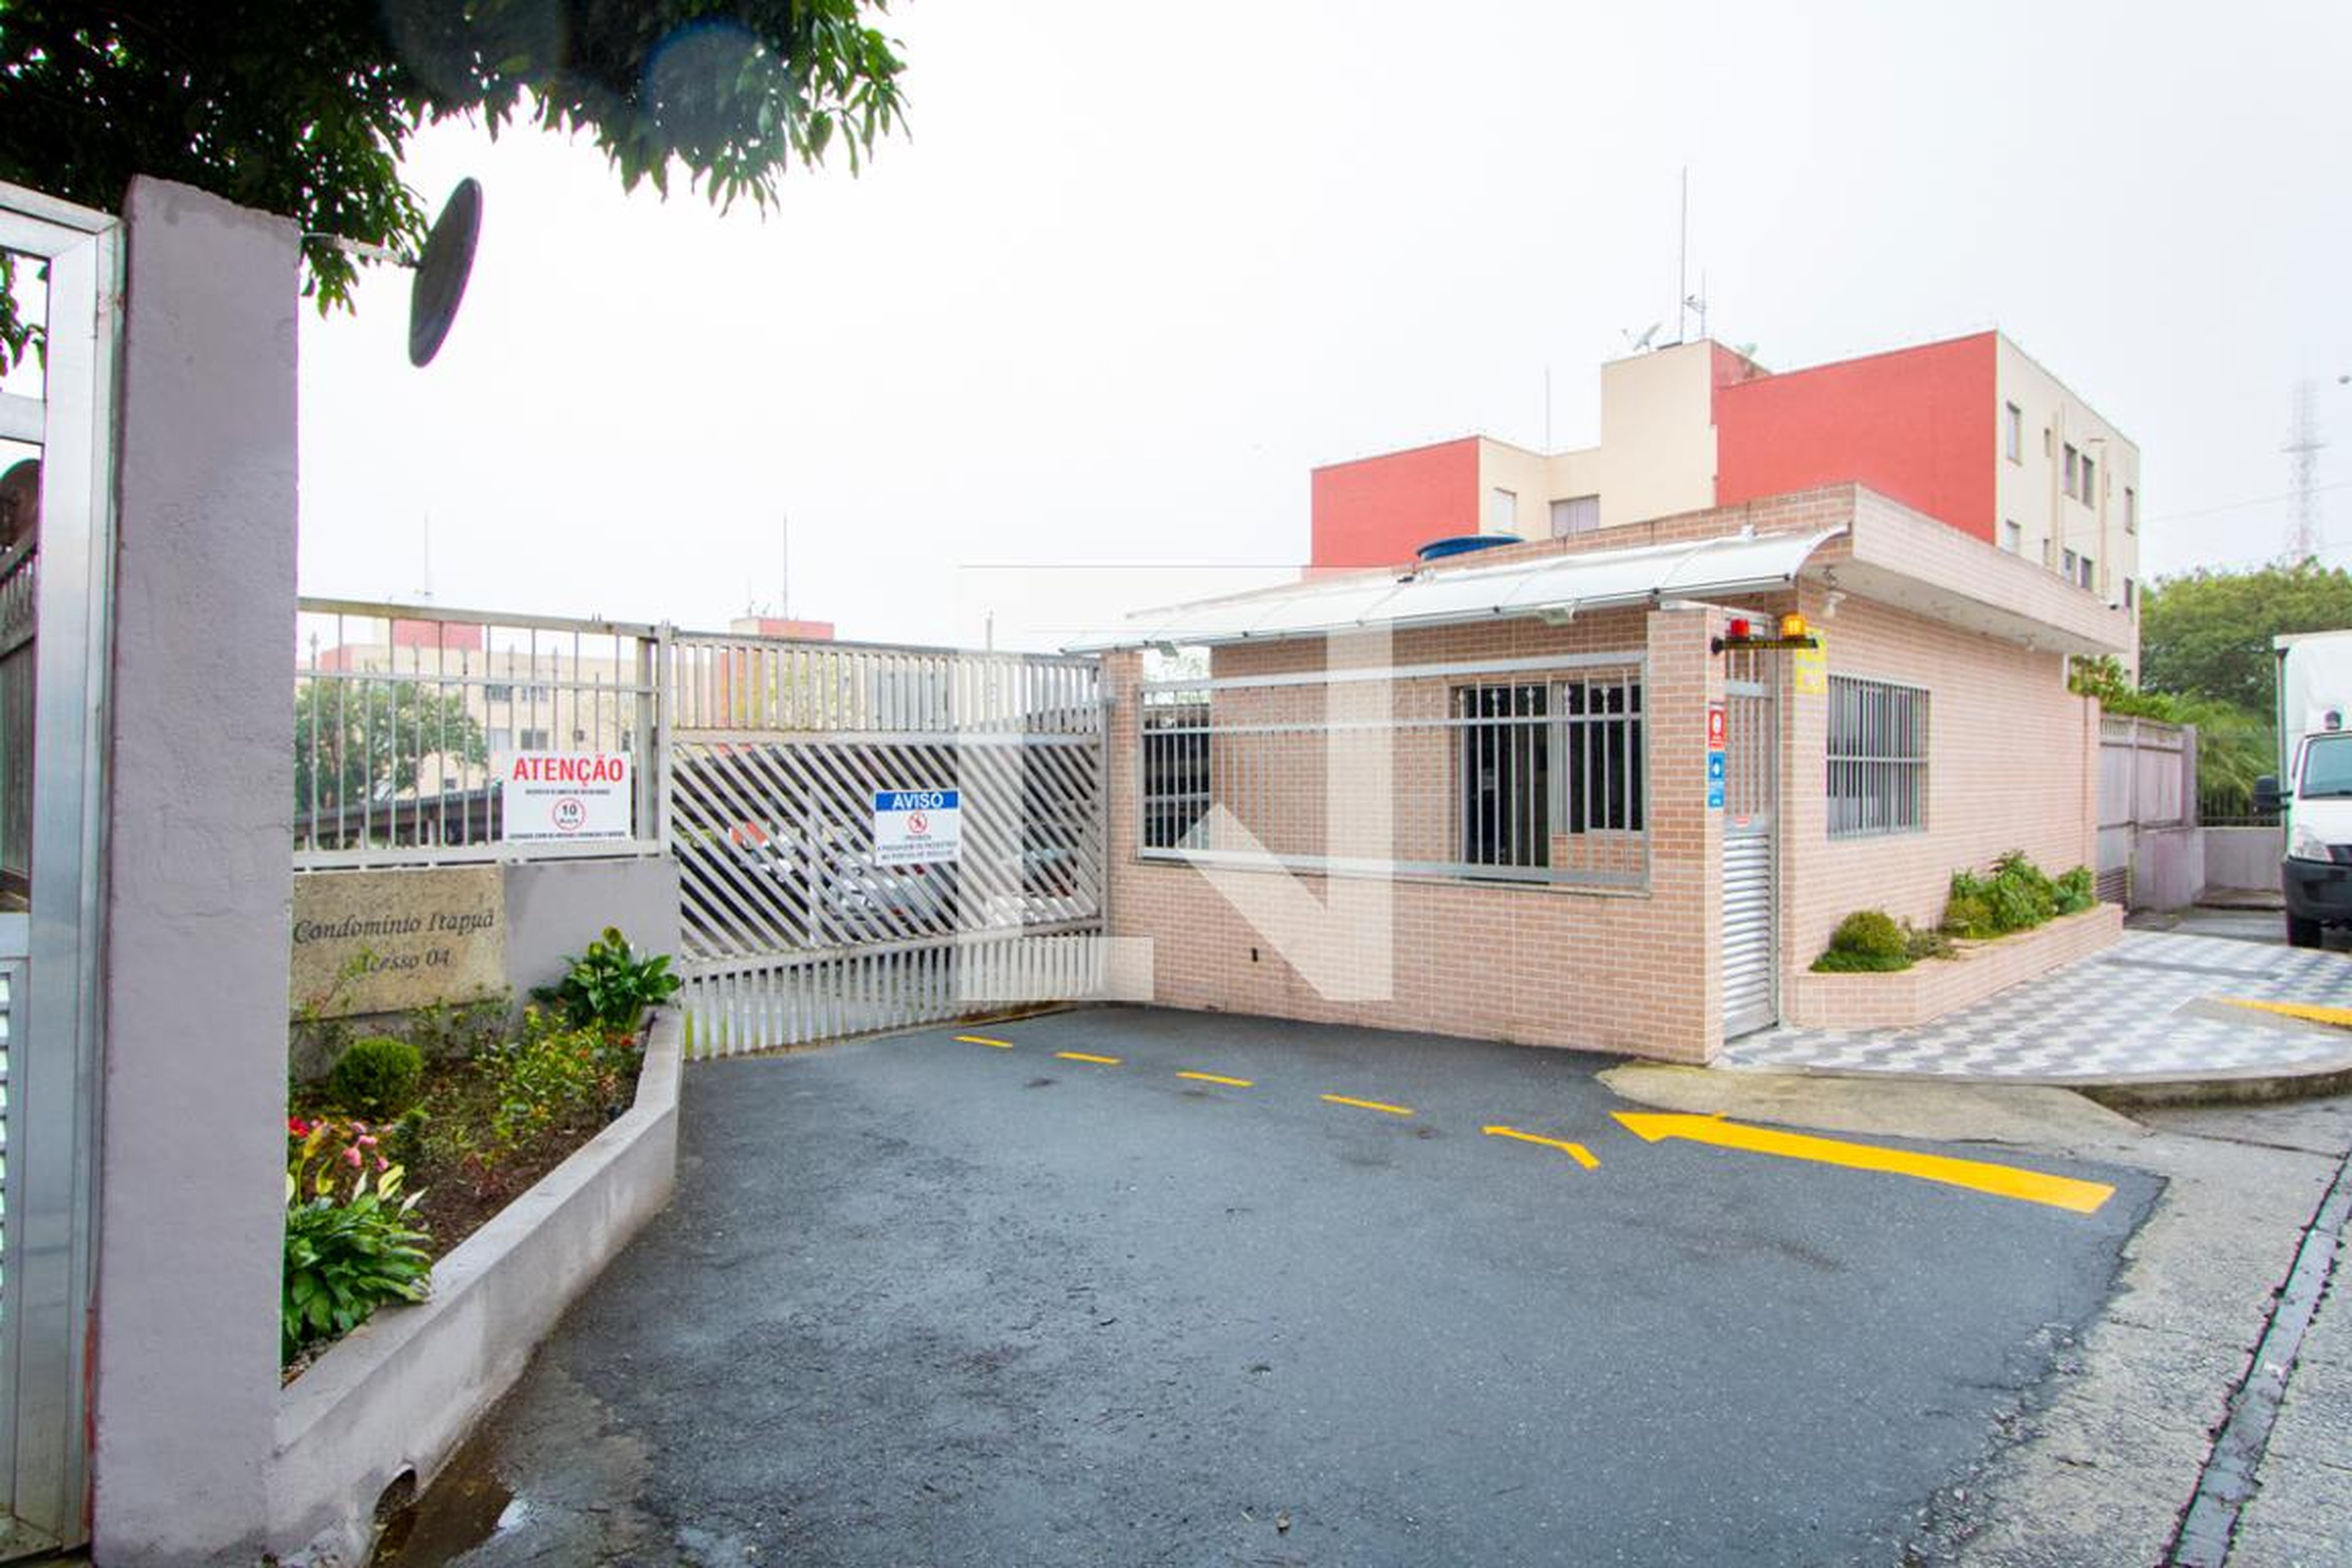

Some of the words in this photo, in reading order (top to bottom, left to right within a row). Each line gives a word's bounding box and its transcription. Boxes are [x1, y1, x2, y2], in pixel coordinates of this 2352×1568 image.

[513, 754, 624, 786] ATENÇÃO
[892, 793, 944, 809] AVISO
[563, 804, 577, 815] 10
